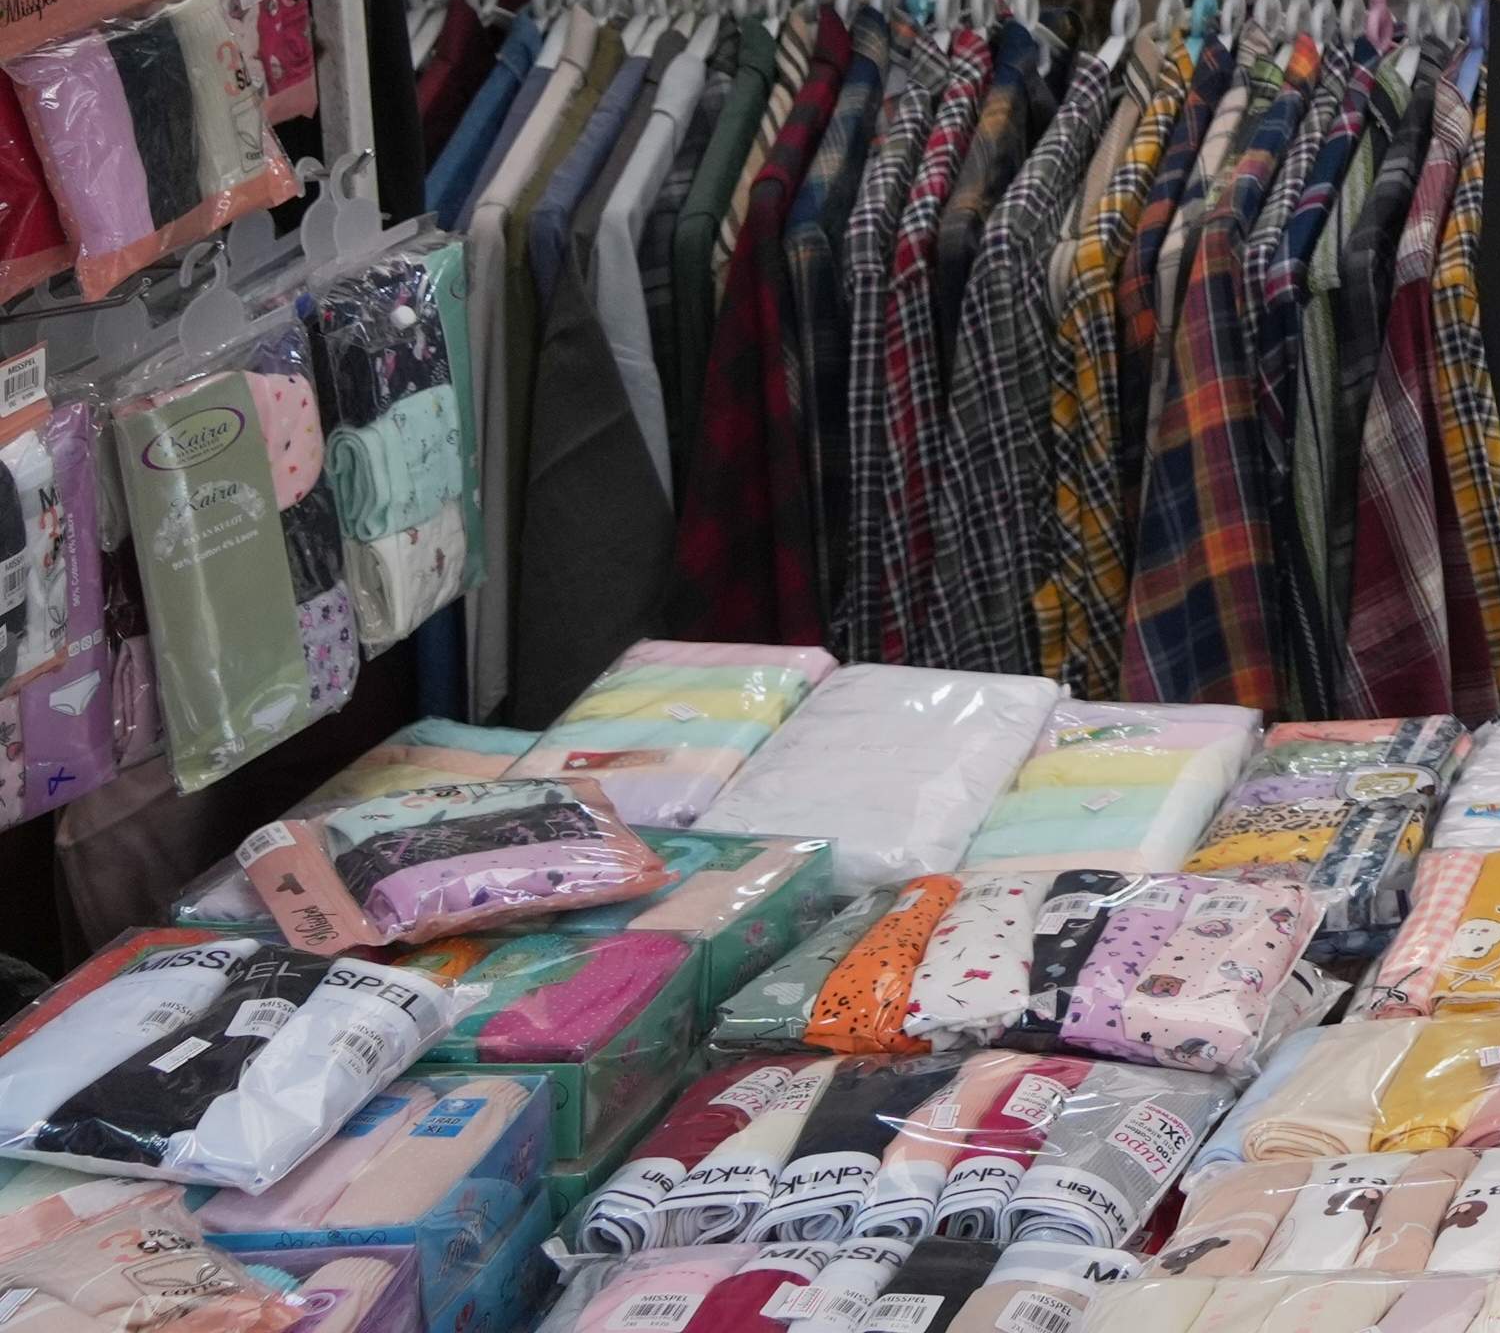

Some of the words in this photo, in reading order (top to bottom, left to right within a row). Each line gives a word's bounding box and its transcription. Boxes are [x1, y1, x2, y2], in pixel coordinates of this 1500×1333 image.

[7, 357, 37, 376] MISSPEL
[157, 421, 229, 456] Kaira
[170, 482, 239, 519] Kaira
[1157, 1117, 1187, 1150] 3XL
[1113, 1131, 1168, 1176] Lupo
[641, 1294, 689, 1303] MISSPEL
[880, 1295, 927, 1304] MISSPEL
[1029, 1292, 1074, 1317] MISSPEL
